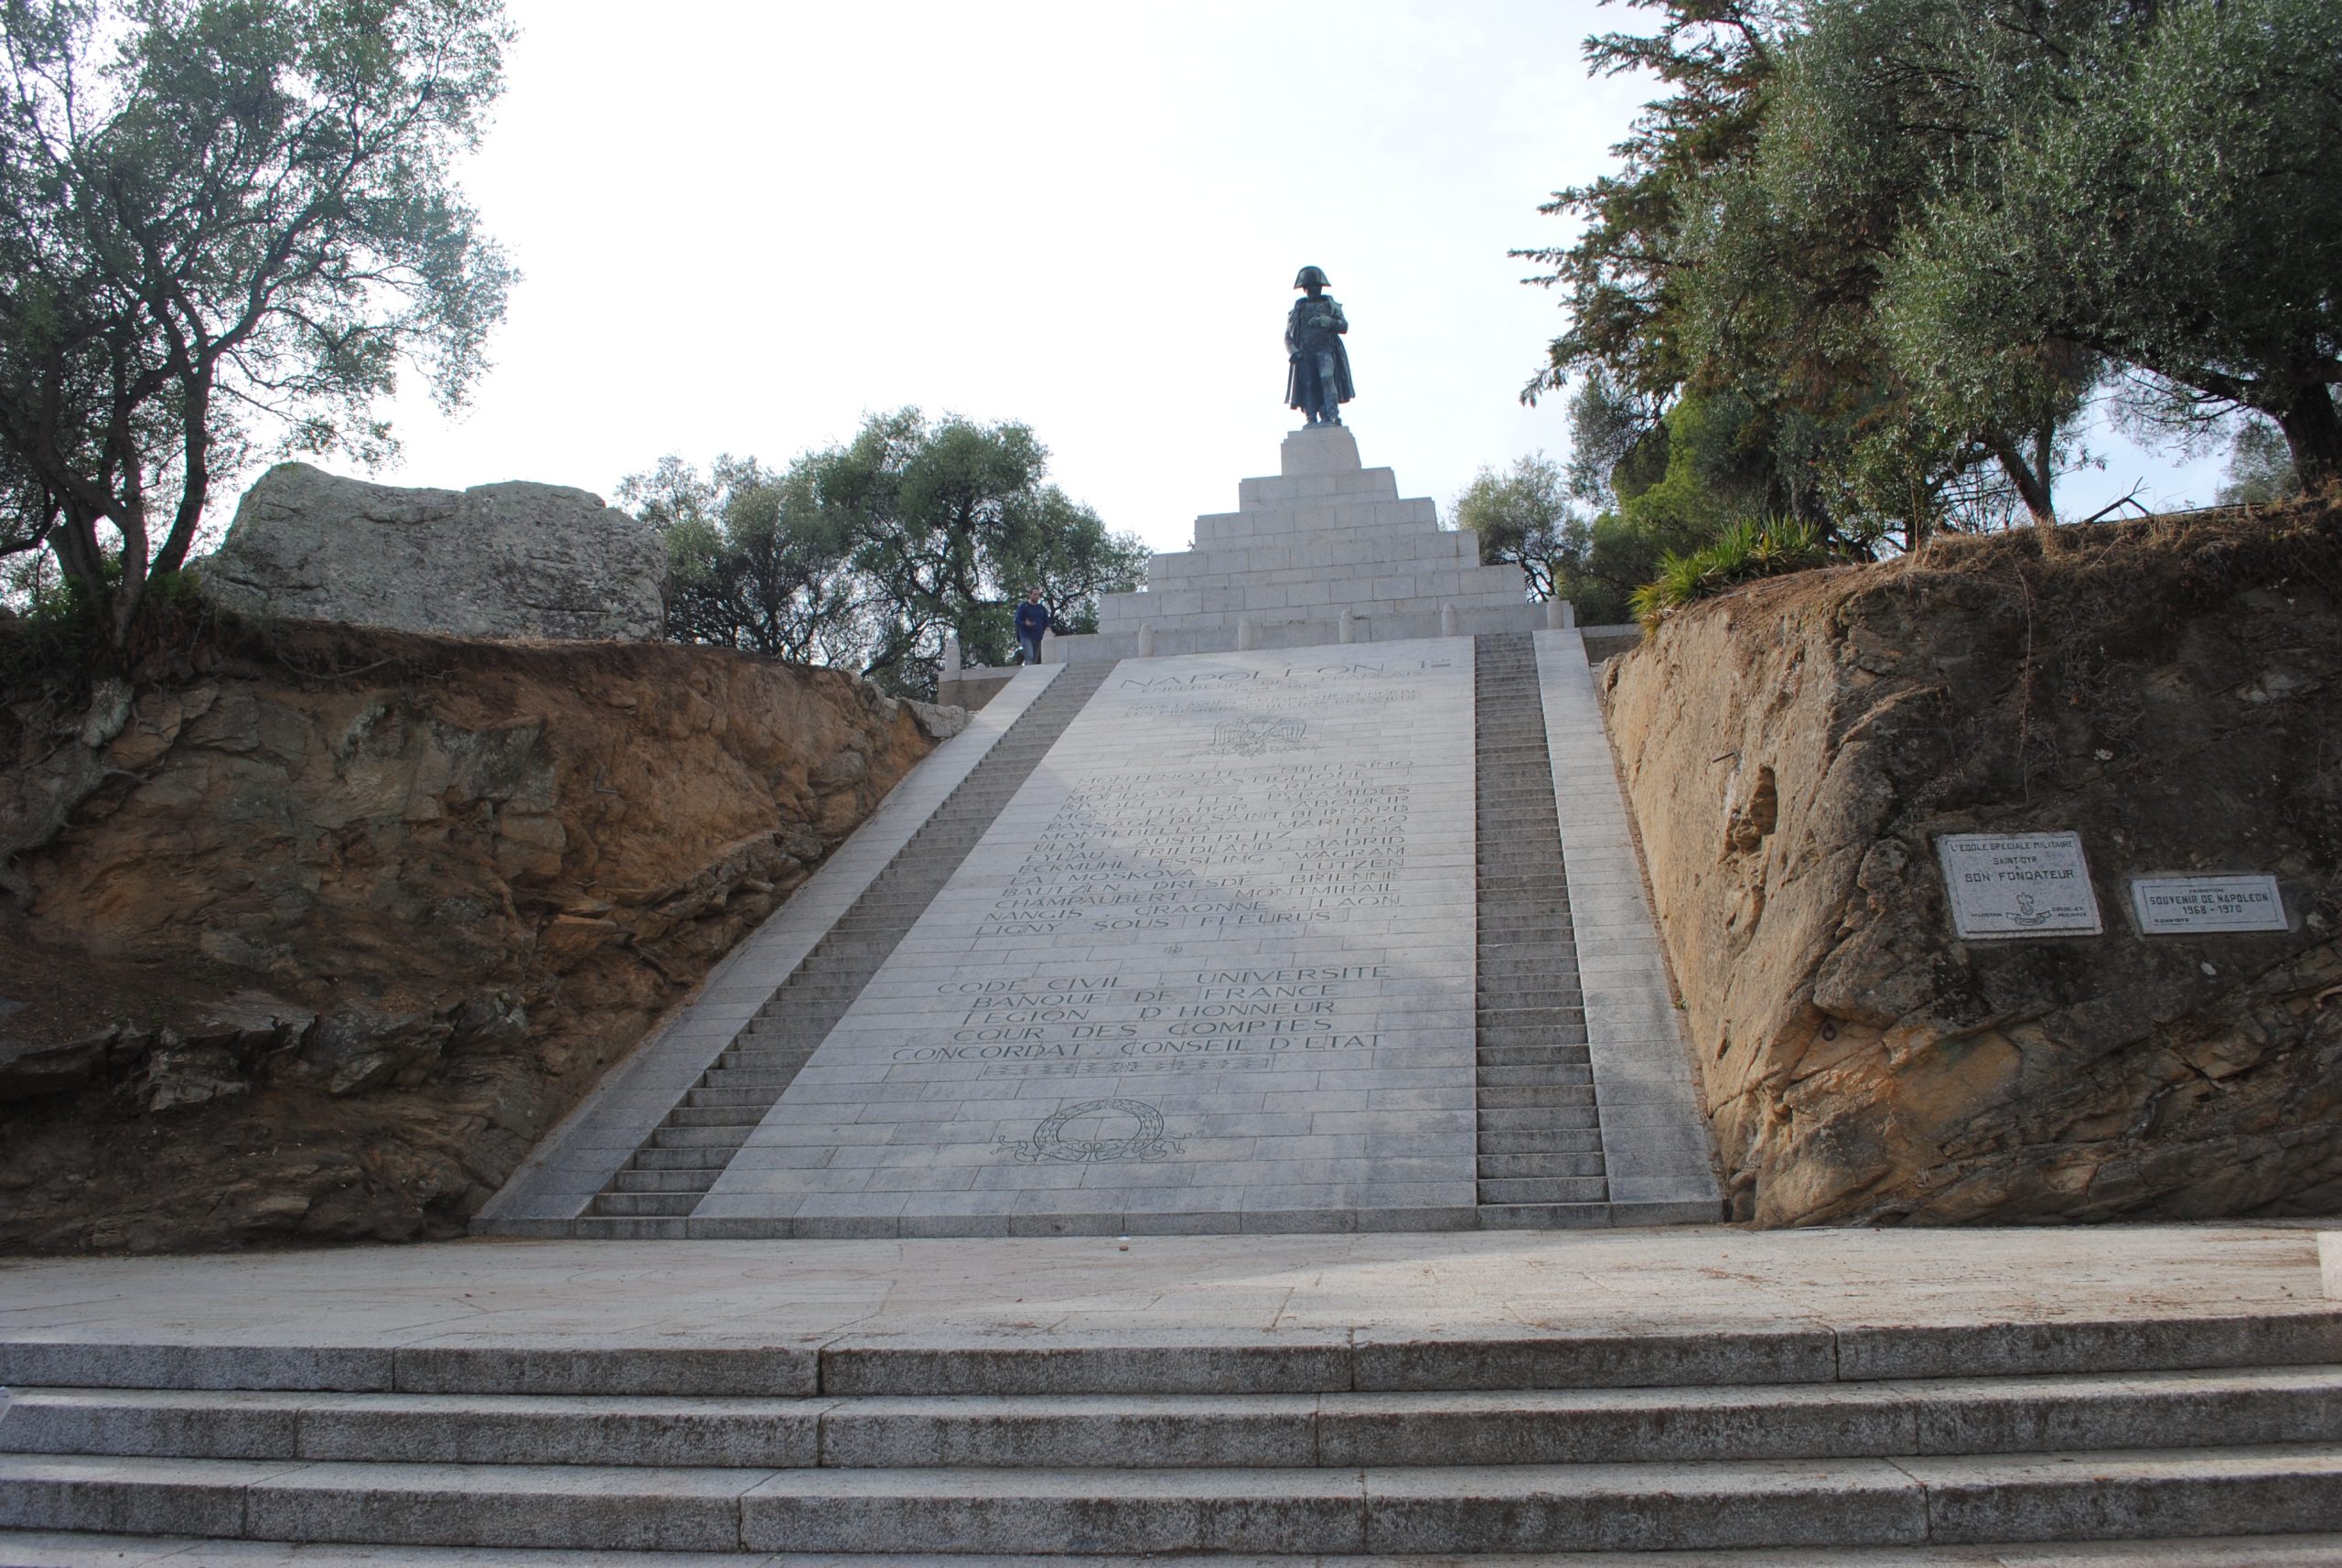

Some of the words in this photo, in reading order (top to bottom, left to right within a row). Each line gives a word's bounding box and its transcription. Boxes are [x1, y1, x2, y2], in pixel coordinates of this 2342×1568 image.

[1267, 787, 1411, 800] PYRAMIDES
[1295, 795, 1409, 808] ABOUKIR
[1040, 825, 1210, 840] MONTEBELLO
[1278, 814, 1407, 828] MARENGO
[1047, 817, 1157, 831] PASSAGE
[1170, 815, 1202, 824] DU
[1292, 805, 1409, 818] BERNARD
[1026, 851, 1105, 862] EYLAU
[1133, 842, 1273, 857] FRIEDLAND
[1305, 836, 1405, 848] MADRID
[1034, 842, 1086, 851] ULM
[1135, 831, 1293, 846] AUSTERLITZ
[1346, 825, 1406, 835] IENA
[1990, 842, 2031, 851] SPECIALE
[2033, 841, 2073, 849] MILITAIRE
[1018, 861, 1127, 873] ECKMUHL
[1157, 854, 1265, 866] ESSLING
[1295, 846, 1405, 859] WAGRAM
[1002, 884, 1121, 897] BAUTZEN
[1153, 876, 1254, 890] DRESDE
[1290, 871, 1400, 884] BRIENNE
[1010, 875, 1042, 886] LA
[1069, 868, 1197, 882] MOSKOVA
[1299, 858, 1404, 871] LUTZEN
[1965, 872, 1990, 883] SON
[1999, 869, 2076, 882] FONDATEUR
[984, 909, 1083, 922] NANGIS
[1134, 901, 1269, 915] CRAONNE
[1318, 895, 1401, 908] LAON
[995, 892, 1181, 908] CHAMPAUBERT
[2150, 895, 2197, 905] SOUVENIR
[2201, 894, 2213, 903] DE
[2218, 893, 2269, 903] NAPOLEON
[2183, 906, 2207, 915] 1968
[2218, 905, 2242, 913] 1970
[975, 921, 1062, 936] LIGNY
[1093, 918, 1170, 930] SOUS
[1200, 912, 1330, 927] FLEURUS
[937, 980, 1027, 993] CODE
[1047, 976, 1128, 990] CIVIL
[1197, 965, 1391, 984] UNIVERSITE
[973, 993, 1107, 1008] BANQUE
[1134, 991, 1176, 1003] DE
[1204, 984, 1339, 1000] FRANCE
[963, 1008, 1089, 1025] LEGION
[953, 1027, 1044, 1041] COUR
[1071, 1024, 1137, 1038] DES
[1168, 1018, 1332, 1035] COMPTES
[892, 1044, 1088, 1060] CONCORDAT
[1121, 1039, 1253, 1054] CONSEIL
